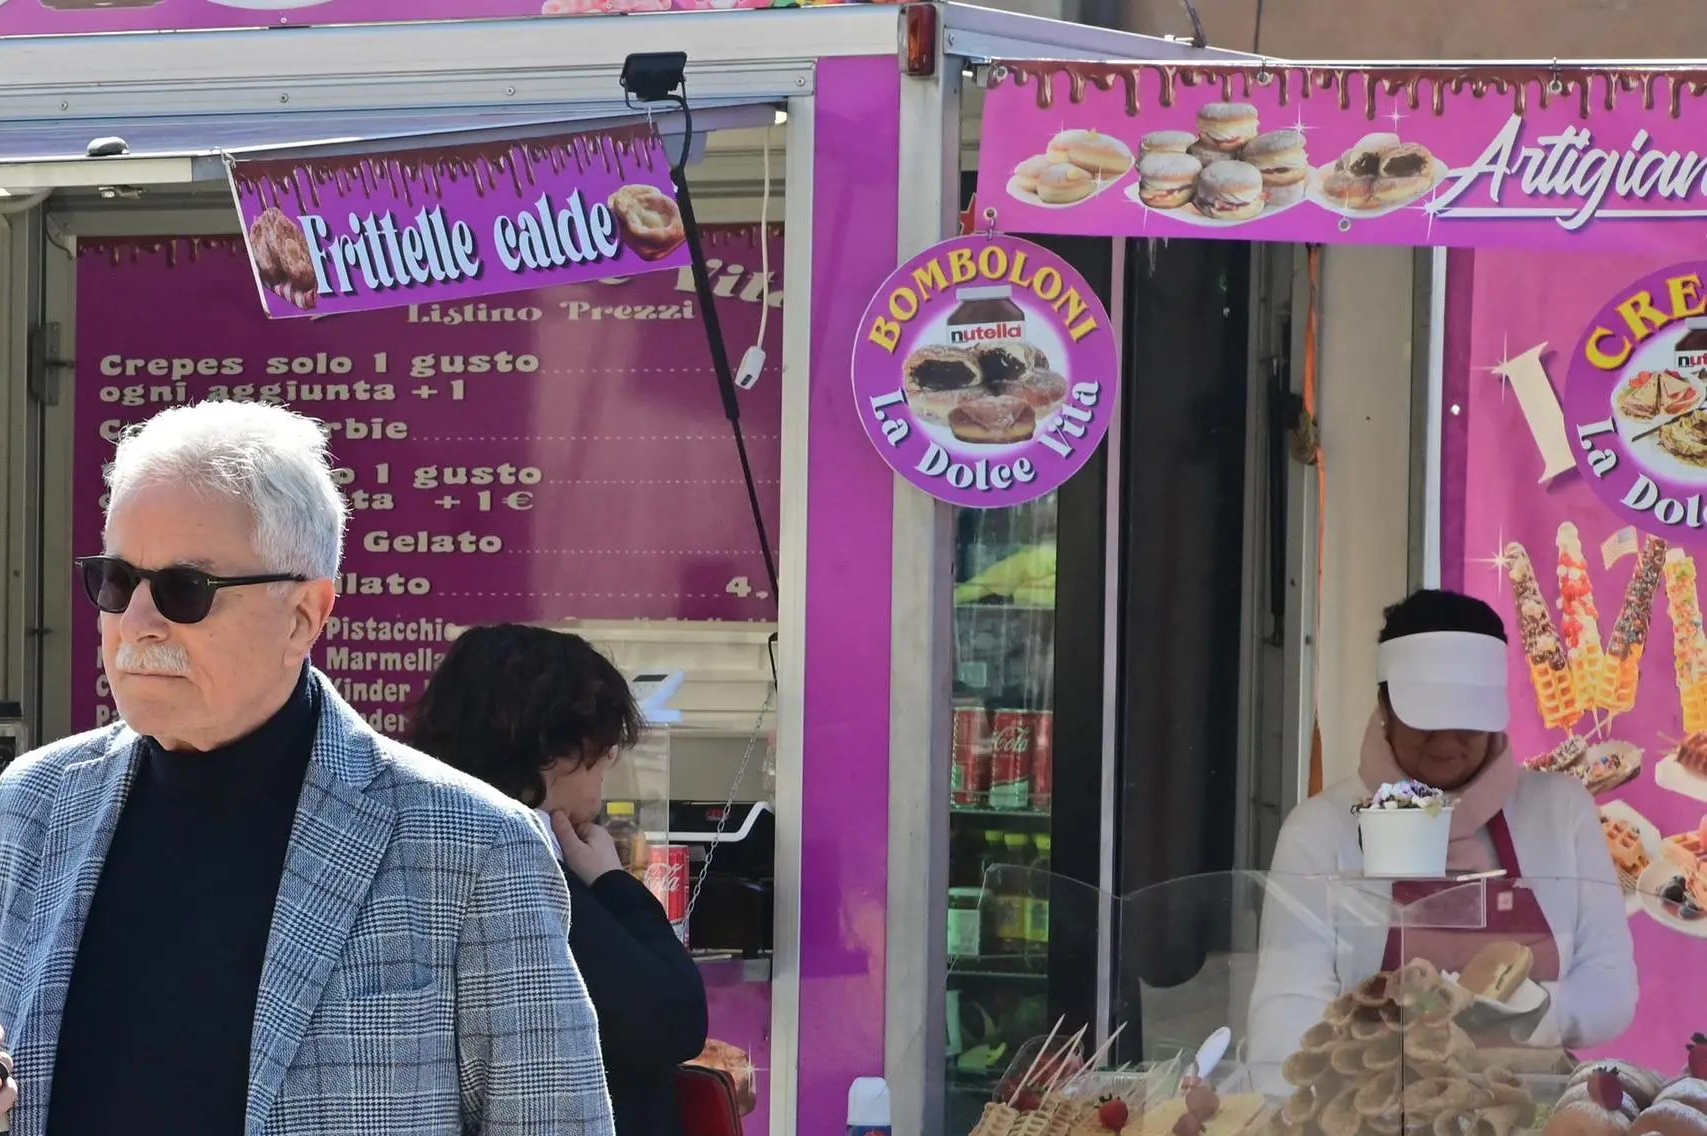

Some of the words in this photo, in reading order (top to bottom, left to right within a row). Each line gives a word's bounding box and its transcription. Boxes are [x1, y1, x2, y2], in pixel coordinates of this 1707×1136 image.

[297, 204, 479, 293] Frittelle
[493, 188, 620, 271] calde
[406, 303, 543, 325] Listino
[559, 300, 695, 321] Prezzi
[868, 246, 1099, 354] BOMBOLONI
[951, 323, 1022, 342] nutella
[100, 354, 243, 380] Crepes
[266, 352, 352, 374] solo
[374, 352, 387, 373] 1
[410, 350, 539, 378] gusto
[100, 381, 188, 406] ogni
[207, 379, 395, 405] aggiunta
[870, 387, 909, 446] La
[915, 442, 1035, 490] Dolce
[1038, 380, 1100, 458] Vita
[413, 464, 542, 489] gusto
[1577, 416, 1618, 477] La
[1620, 473, 1707, 528] Dol
[363, 531, 502, 553] Gelato
